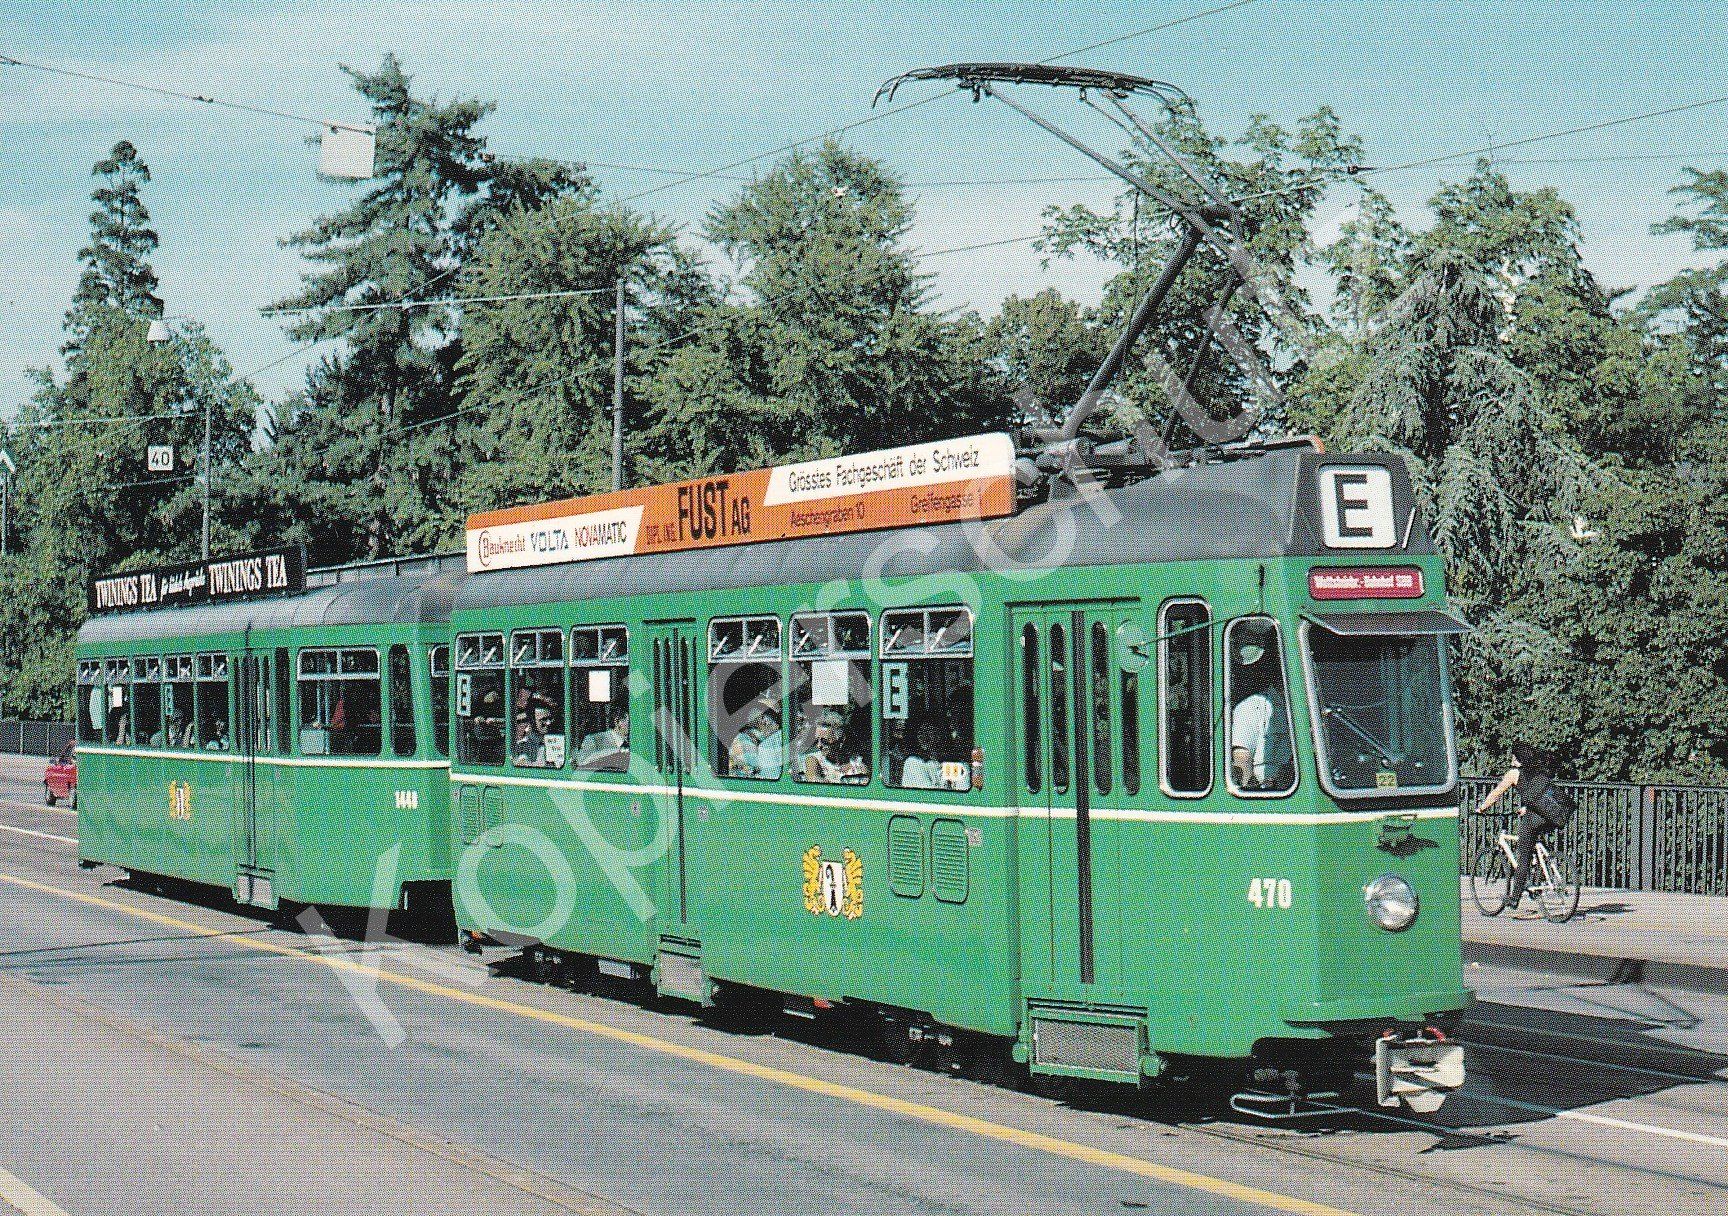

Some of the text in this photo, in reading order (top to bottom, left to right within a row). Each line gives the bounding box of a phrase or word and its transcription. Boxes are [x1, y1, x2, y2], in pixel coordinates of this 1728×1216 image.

[151, 451, 170, 466] 40
[788, 445, 980, 493] Grösstes Fachgeschäft der Schweiz
[677, 480, 730, 541] FUST
[731, 496, 751, 536] AG
[855, 501, 865, 520] 10
[910, 488, 974, 514] Greifengasse
[1334, 473, 1374, 538] E
[530, 528, 569, 553] VOLTA
[574, 520, 628, 547] NOVAMATIC
[95, 575, 138, 608] TWININGS
[140, 574, 158, 602] TEA
[208, 557, 263, 596] TWININGS
[266, 554, 288, 588] TEA
[1379, 774, 1396, 787] 22
[1248, 878, 1292, 909] 470
